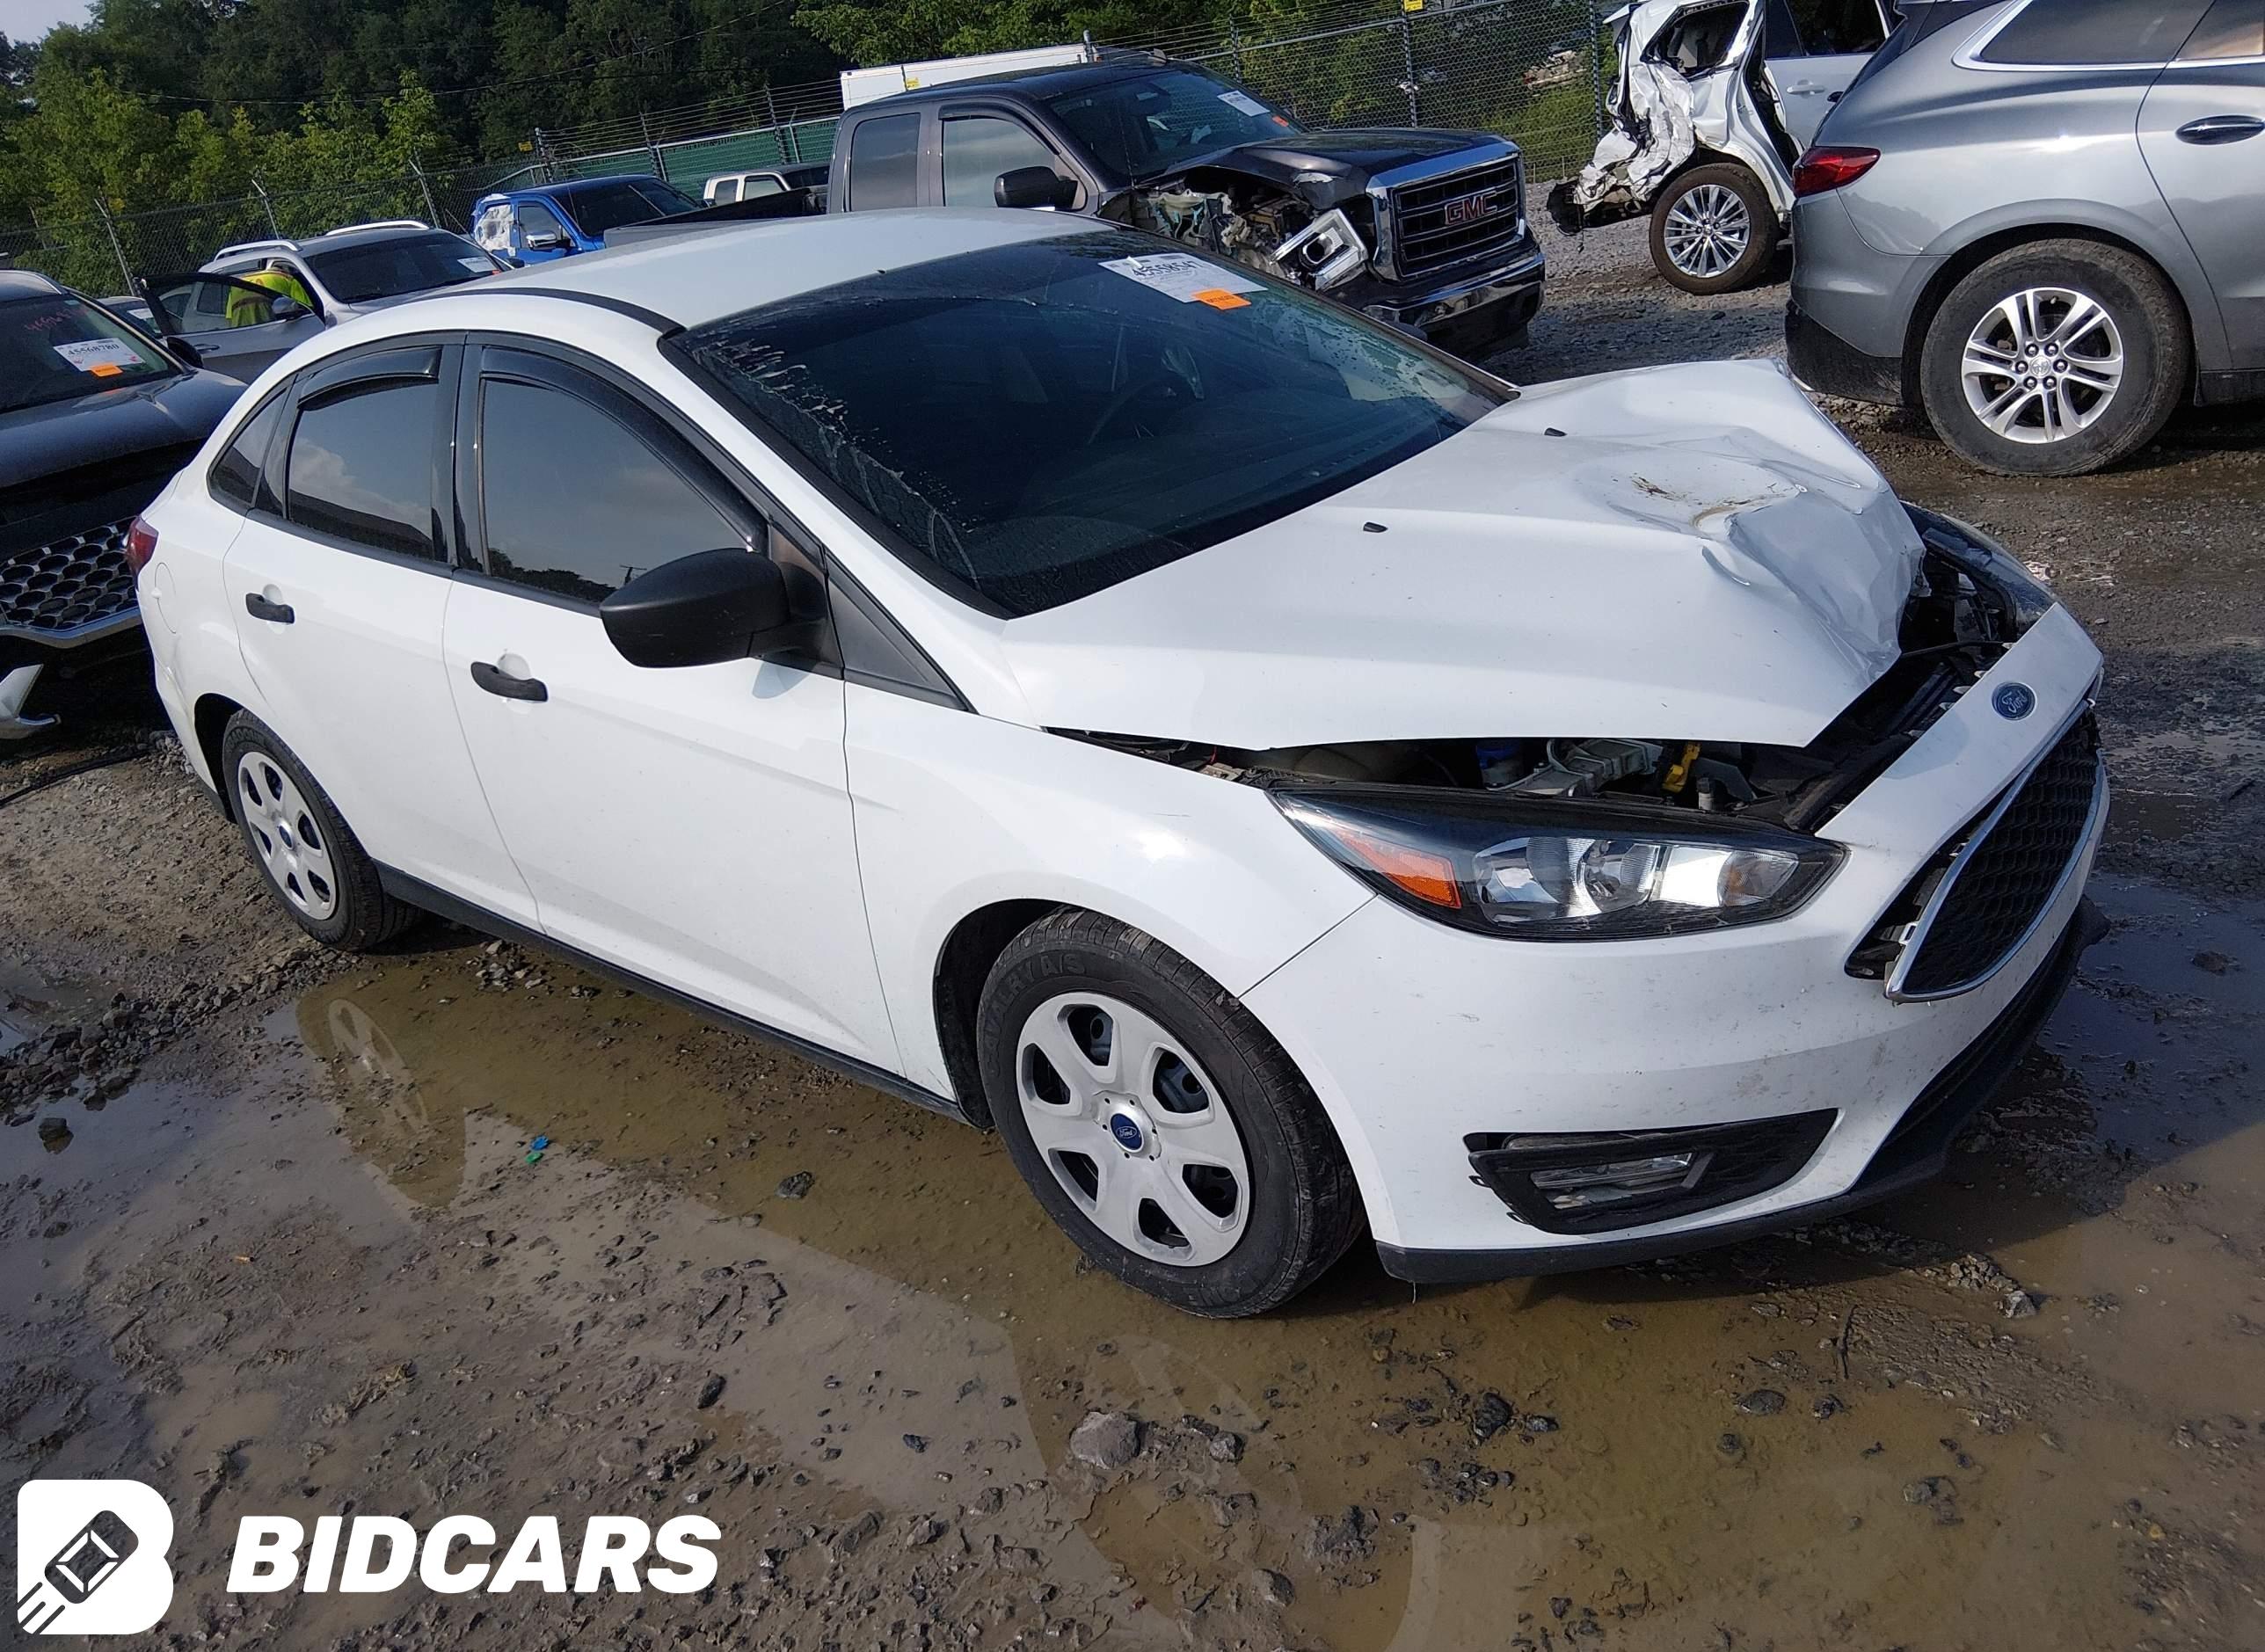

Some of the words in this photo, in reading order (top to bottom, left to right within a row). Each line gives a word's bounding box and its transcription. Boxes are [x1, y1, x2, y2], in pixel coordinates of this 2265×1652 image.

[1445, 189, 1498, 226] GMC
[1999, 688, 2029, 715] Ford
[1118, 1127, 1135, 1138] Ford
